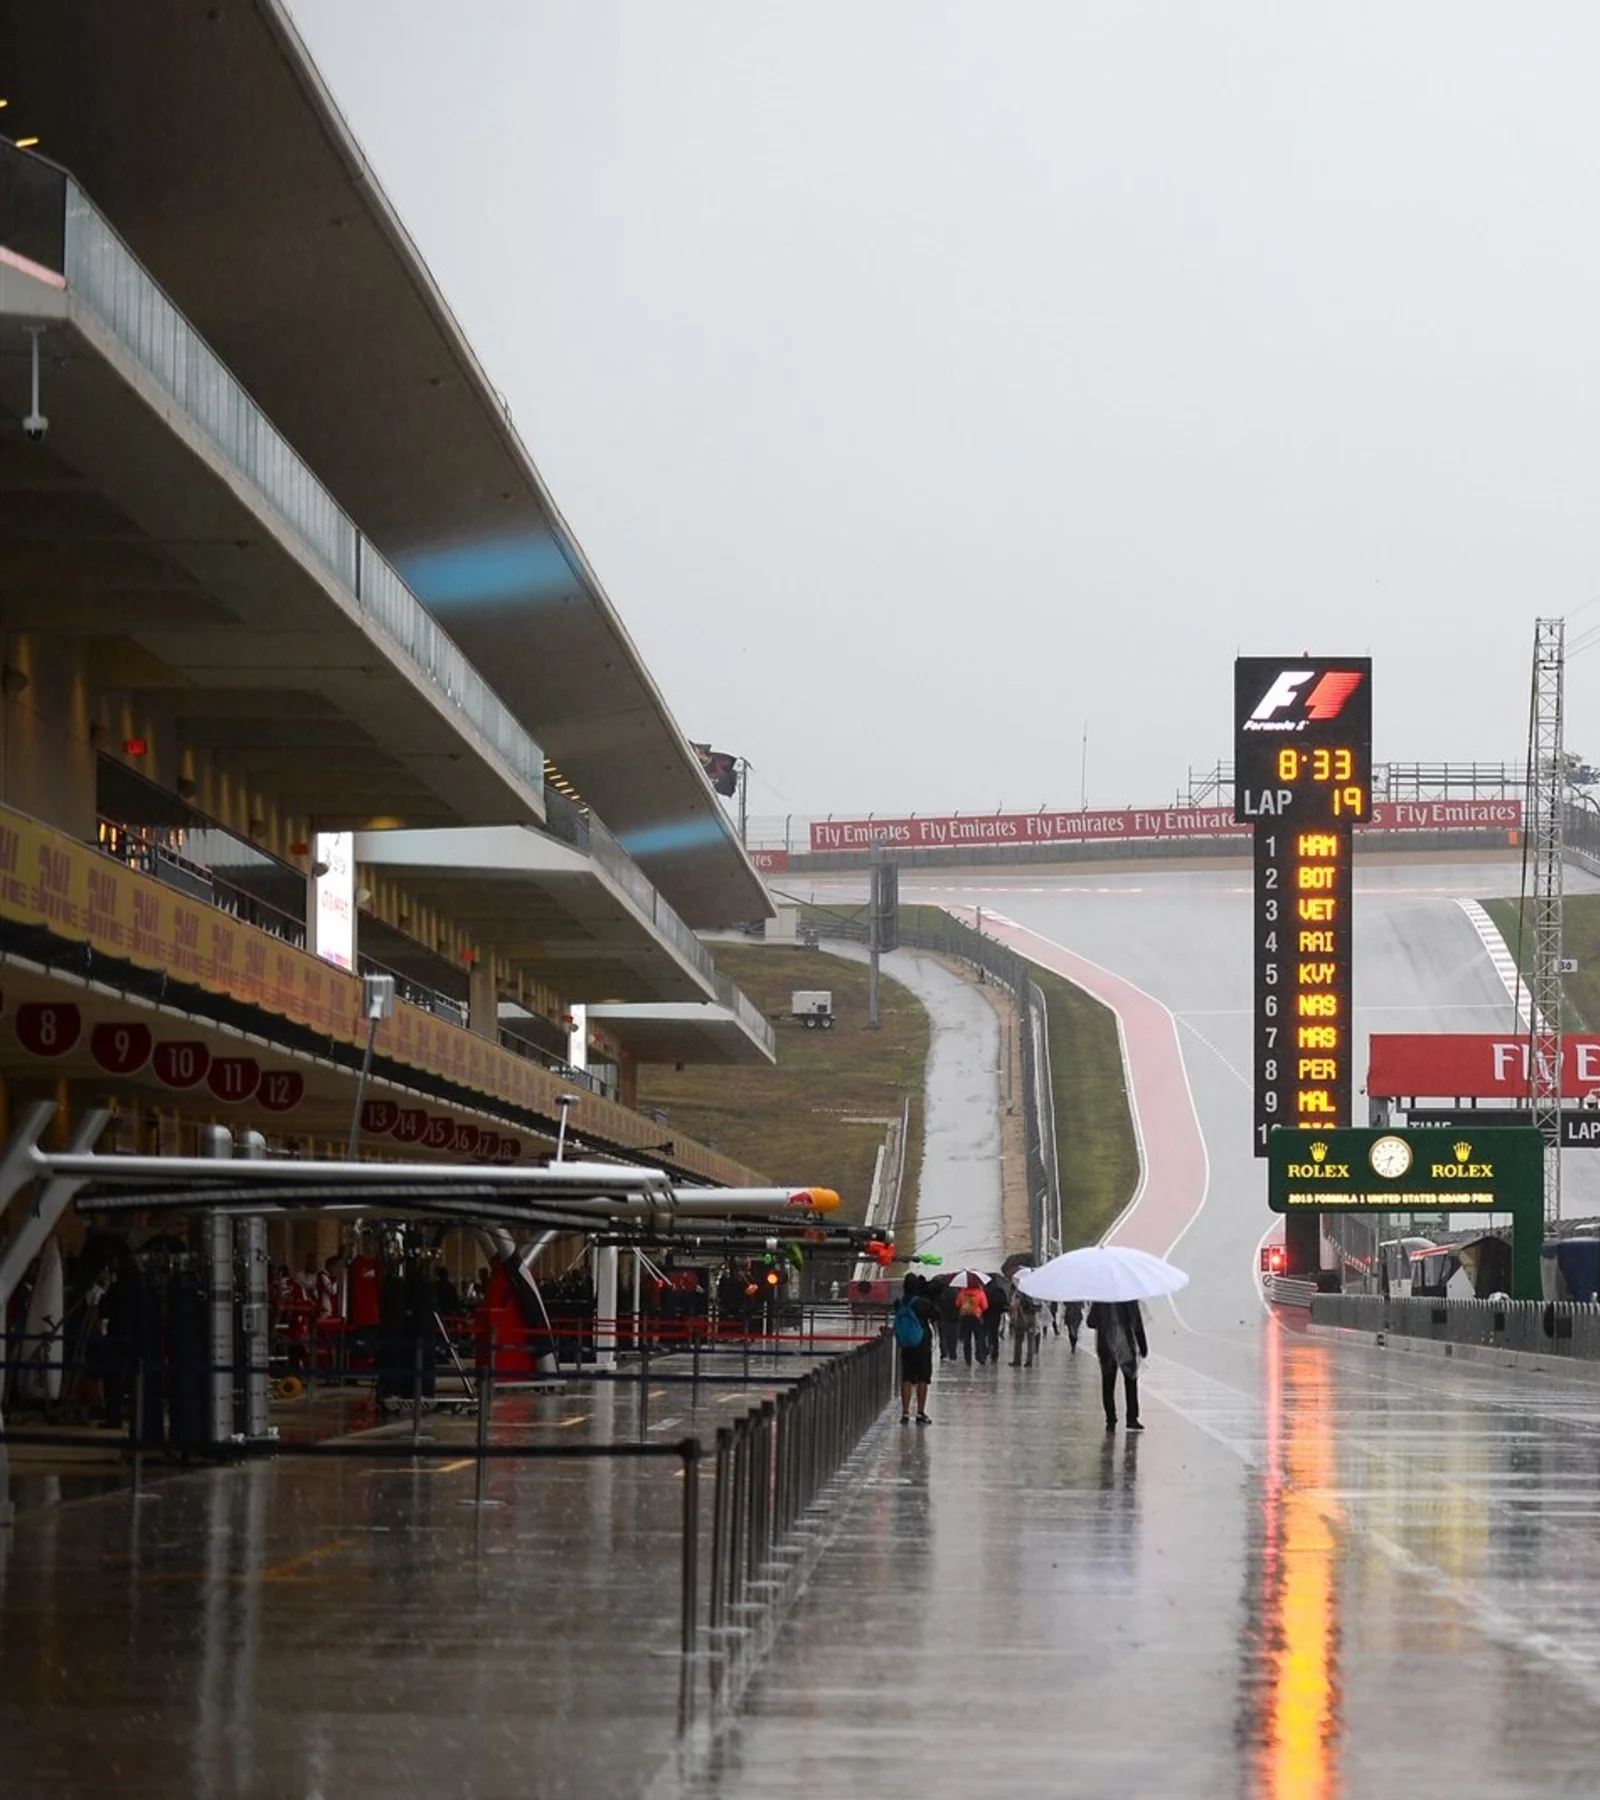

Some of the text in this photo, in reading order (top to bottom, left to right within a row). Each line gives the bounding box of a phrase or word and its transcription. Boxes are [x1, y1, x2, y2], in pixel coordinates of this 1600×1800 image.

[1244, 789, 1293, 815] LAP
[1333, 787, 1362, 816] 19
[1134, 811, 1247, 833] Fly Emirate
[1396, 806, 1427, 825] Fly
[1432, 803, 1515, 821] Emirates
[815, 823, 910, 847] Fly Emirates
[921, 819, 1017, 843] Fly Emirates
[1026, 814, 1124, 838] Fly Emirates
[1265, 835, 1337, 857] 1 HAM
[1265, 867, 1336, 889] 2 BOT
[1265, 899, 1336, 921] 3 VET
[1265, 931, 1335, 952] 4 RAI
[1265, 963, 1336, 985] 5 KVY
[1265, 995, 1337, 1017] 6 NAS
[40, 1010, 56, 1046] 8
[1265, 1027, 1337, 1048] 7 MAS
[114, 1030, 129, 1063] 9
[168, 1048, 194, 1078] 10
[1265, 1059, 1336, 1080] 8 PER
[1492, 1043, 1563, 1089] Fly
[224, 1063, 243, 1092] 11
[268, 1076, 290, 1104] 12
[1265, 1090, 1336, 1112] 9 MAL
[369, 1104, 387, 1128] 13
[401, 1111, 416, 1136] 14
[430, 1120, 445, 1143] 15
[1258, 1123, 1282, 1145] 1
[1568, 1122, 1600, 1139] LAP
[1287, 1164, 1350, 1178] ROLEX
[1431, 1164, 1494, 1178] ROLEX
[1315, 1193, 1358, 1204] FORMULA
[1367, 1193, 1400, 1204] UNITED
[1402, 1193, 1436, 1204] STATES
[1438, 1193, 1470, 1204] GRAND
[1472, 1193, 1494, 1204] PRIX
